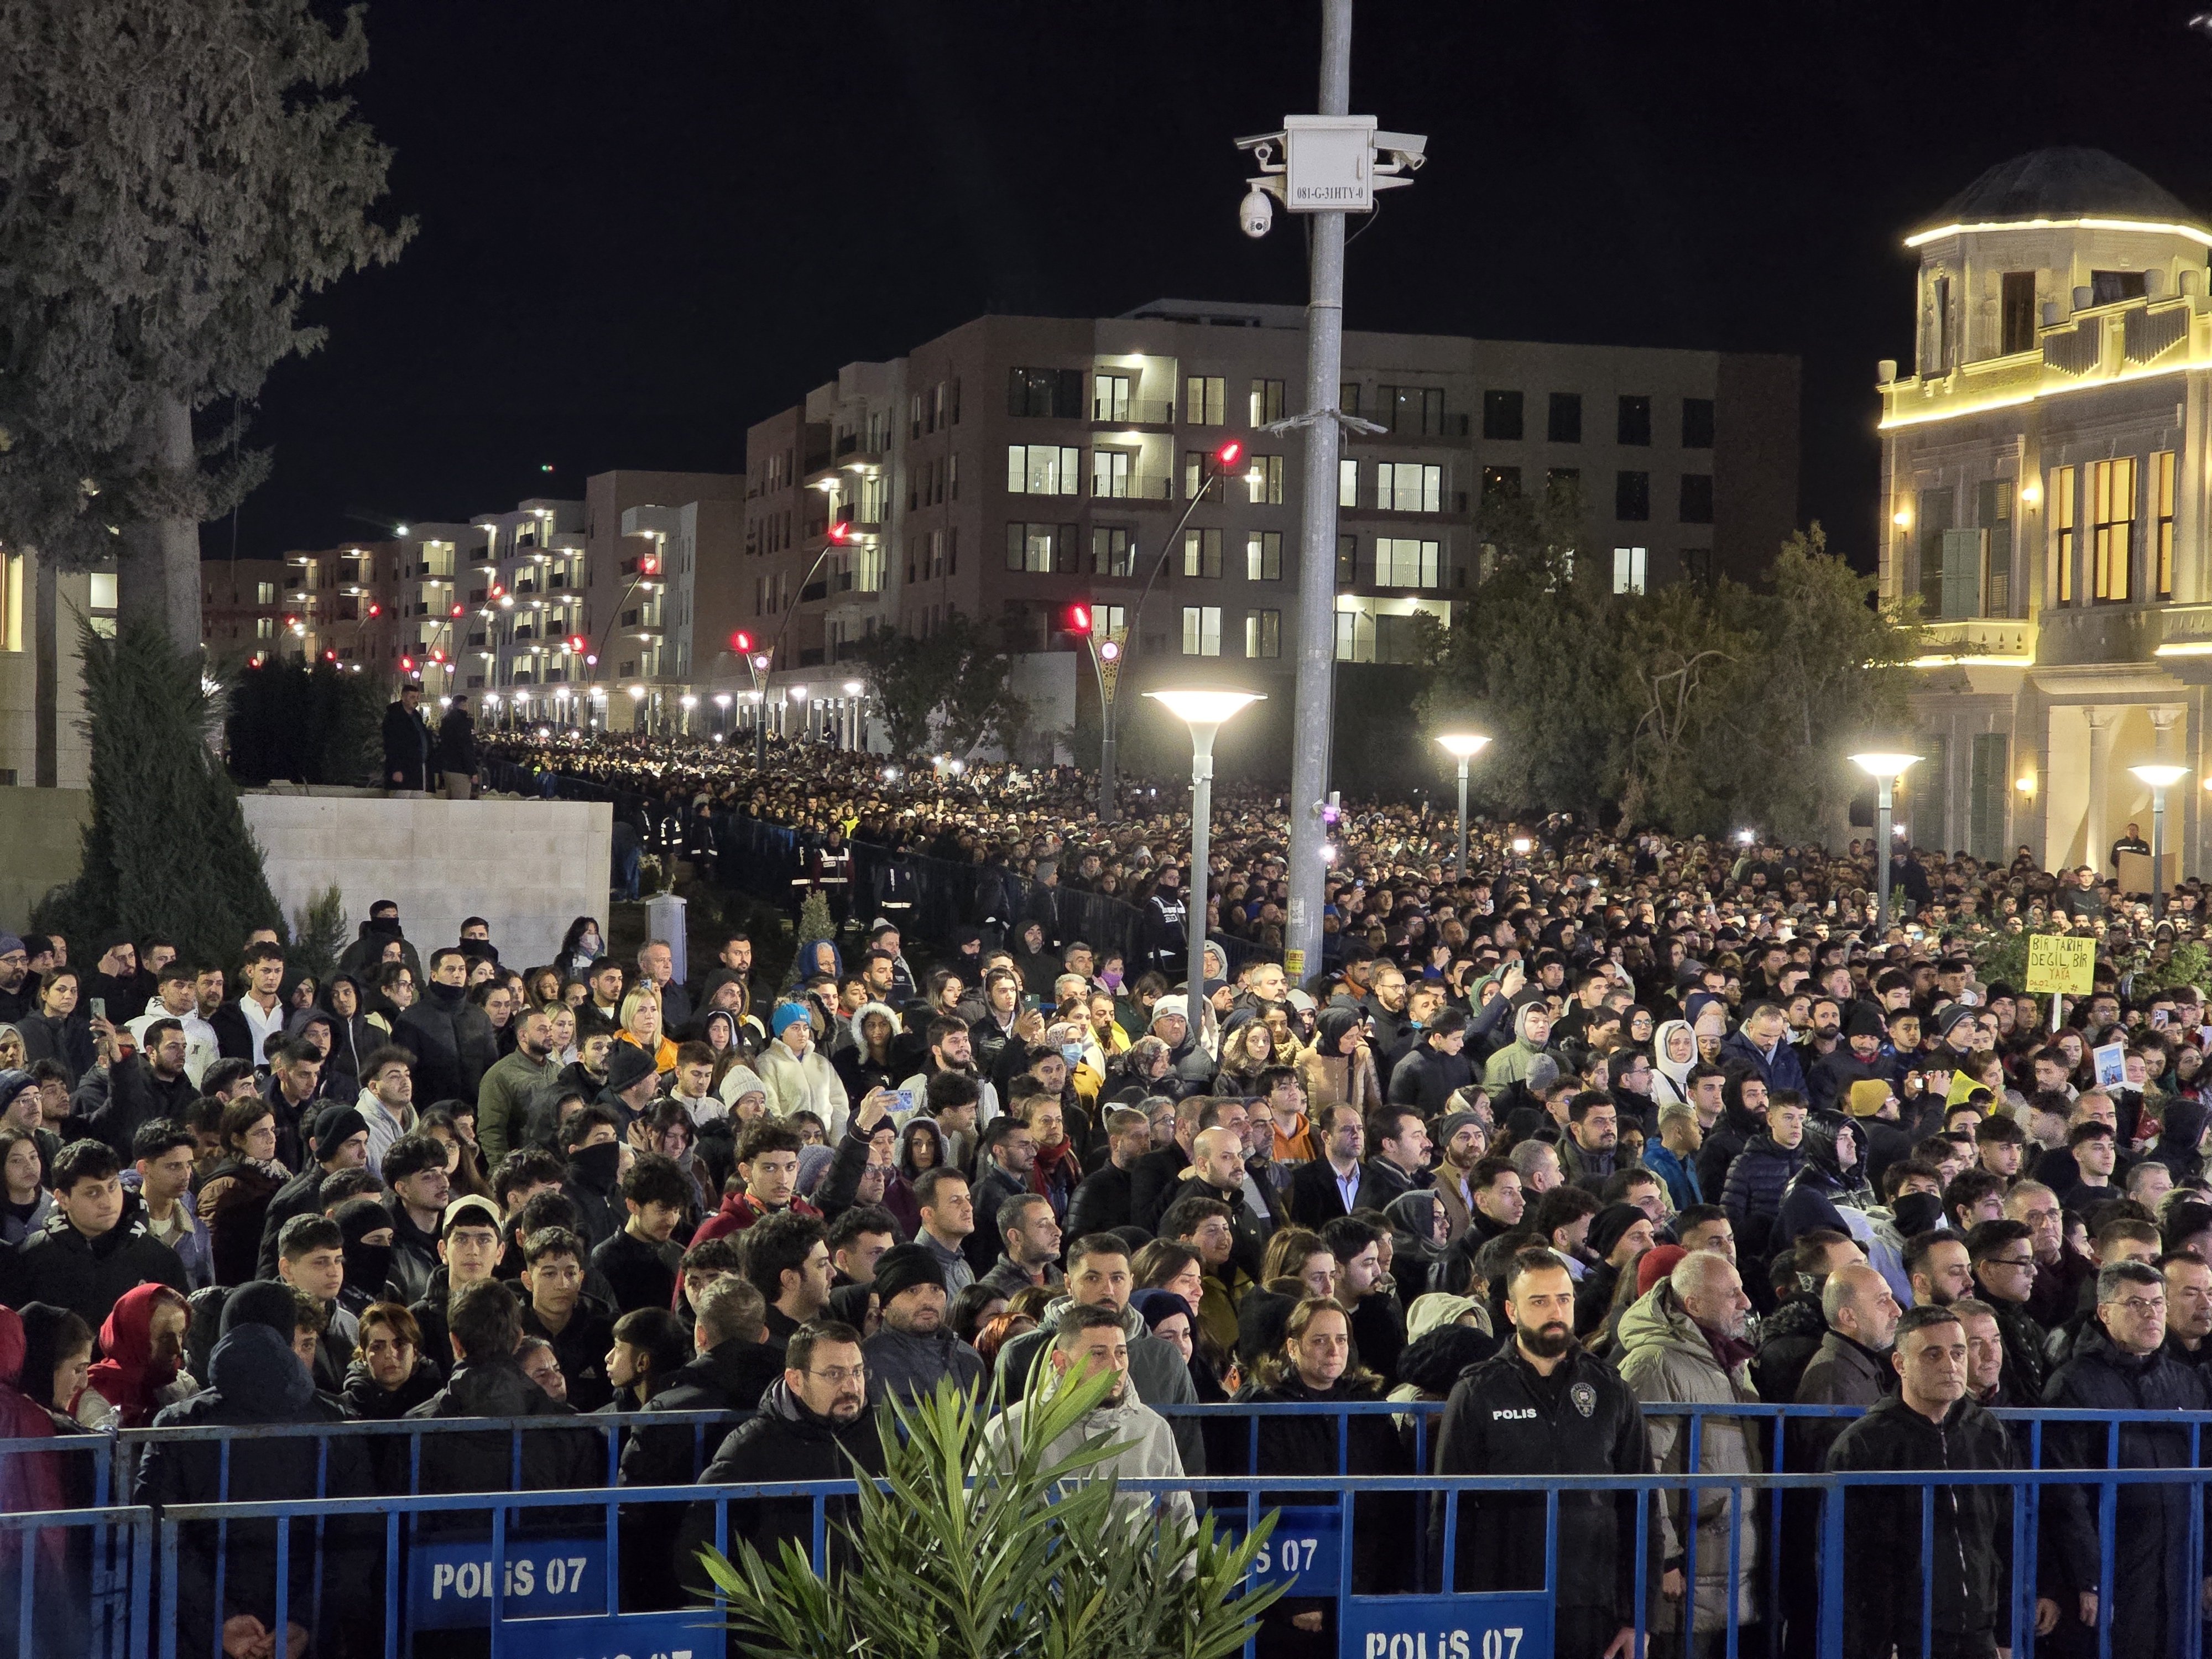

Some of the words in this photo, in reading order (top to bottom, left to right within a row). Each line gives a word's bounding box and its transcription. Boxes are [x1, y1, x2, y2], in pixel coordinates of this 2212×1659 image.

[2049, 968, 2070, 980] YARA
[1282, 1538, 1317, 1572] 07
[546, 1557, 587, 1595] 07
[1482, 1627, 1524, 1659] 07
